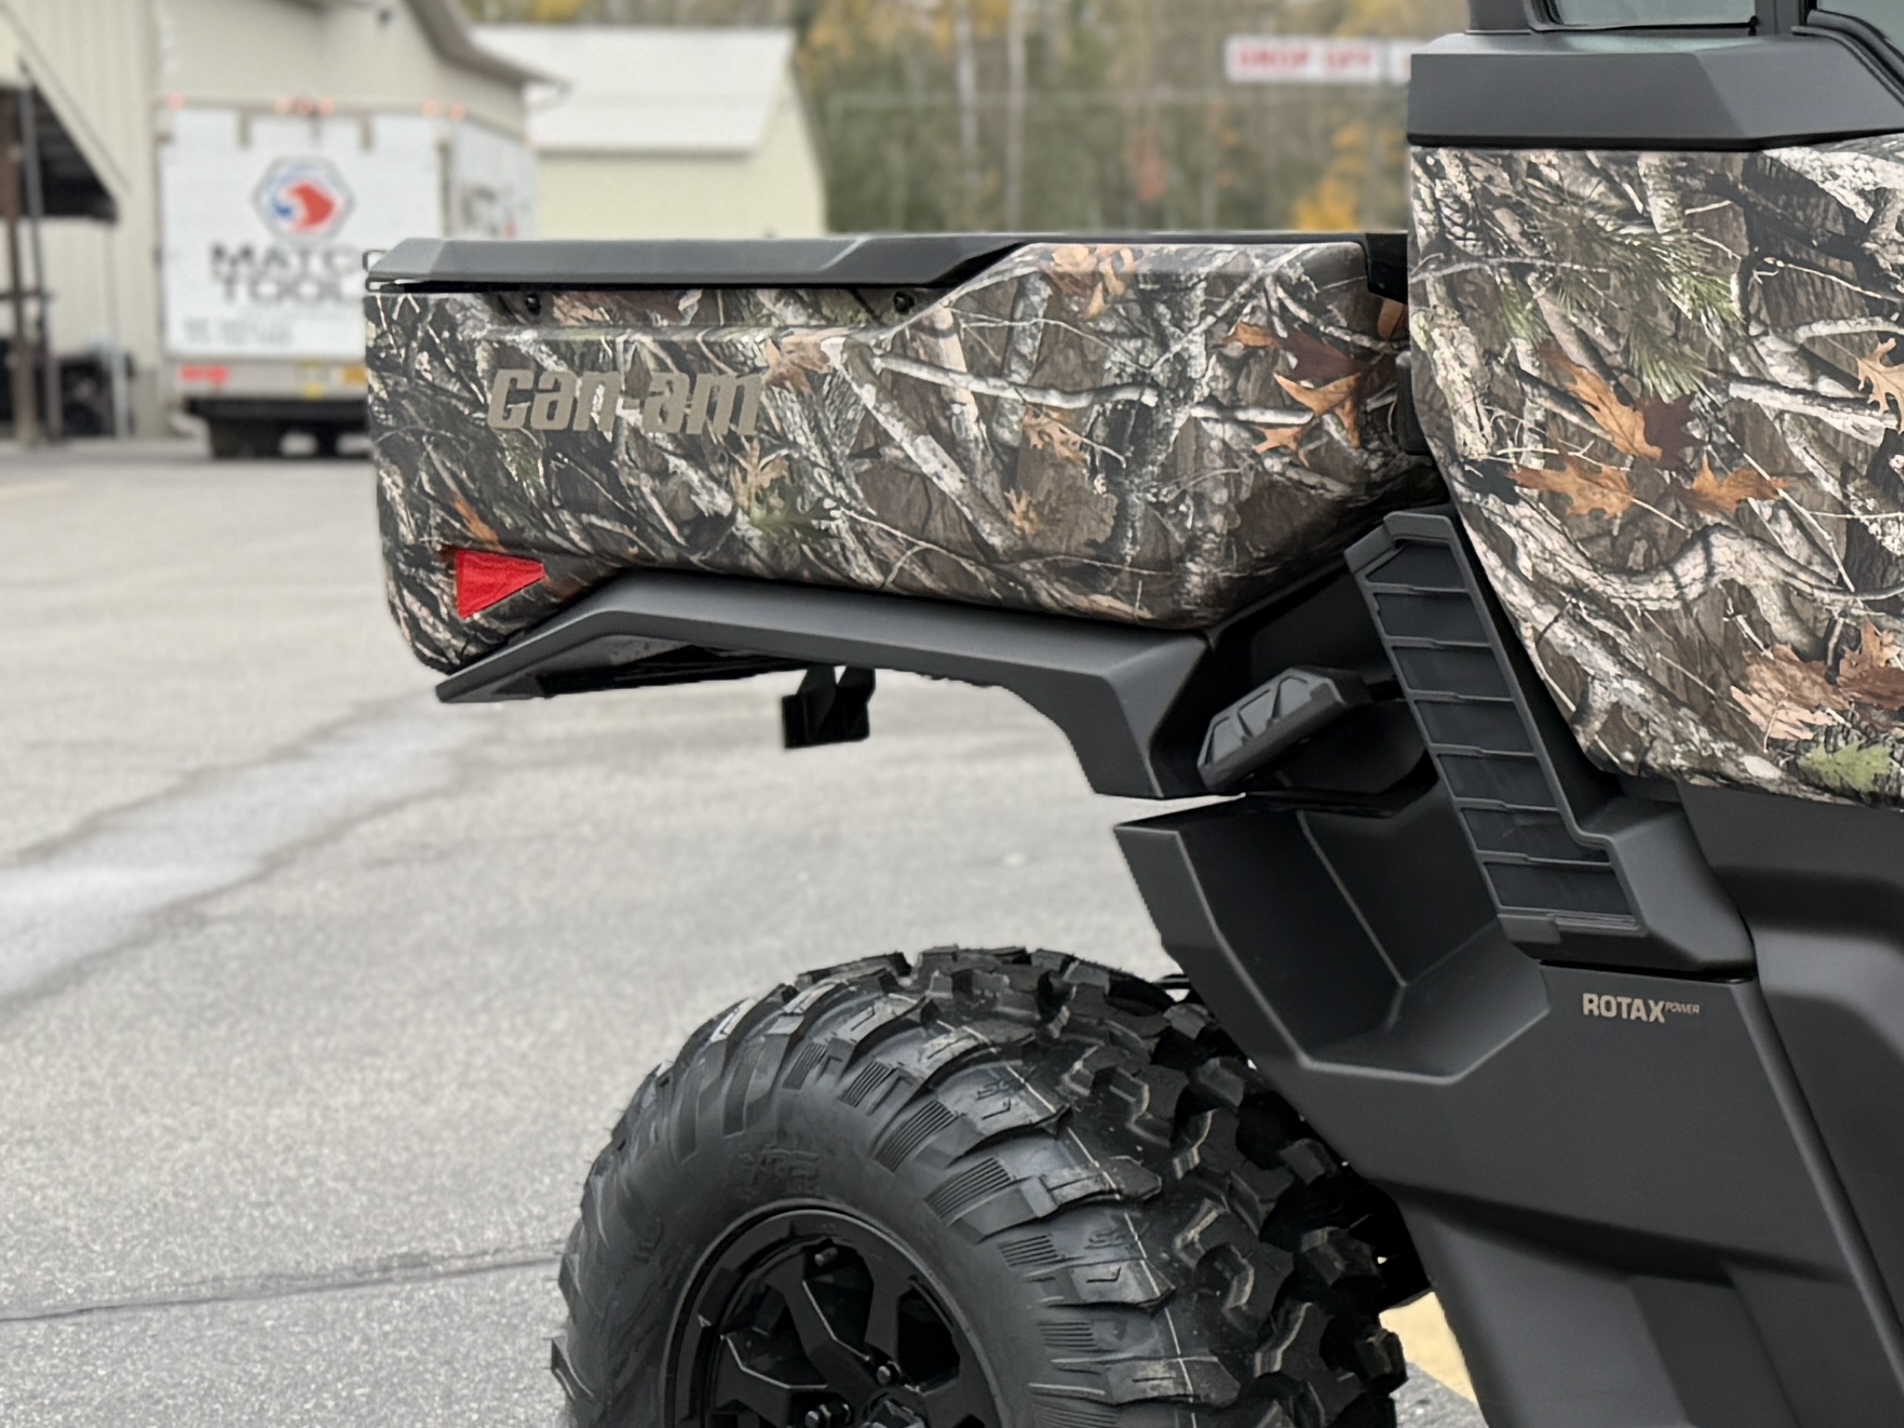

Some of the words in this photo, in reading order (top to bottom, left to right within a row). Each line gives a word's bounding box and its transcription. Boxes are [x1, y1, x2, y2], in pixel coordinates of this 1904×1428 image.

[211, 244, 364, 283] MATC
[220, 273, 366, 305] TOOL
[1583, 993, 1666, 1023] ROTAX
[1664, 1001, 1701, 1015] POWER
